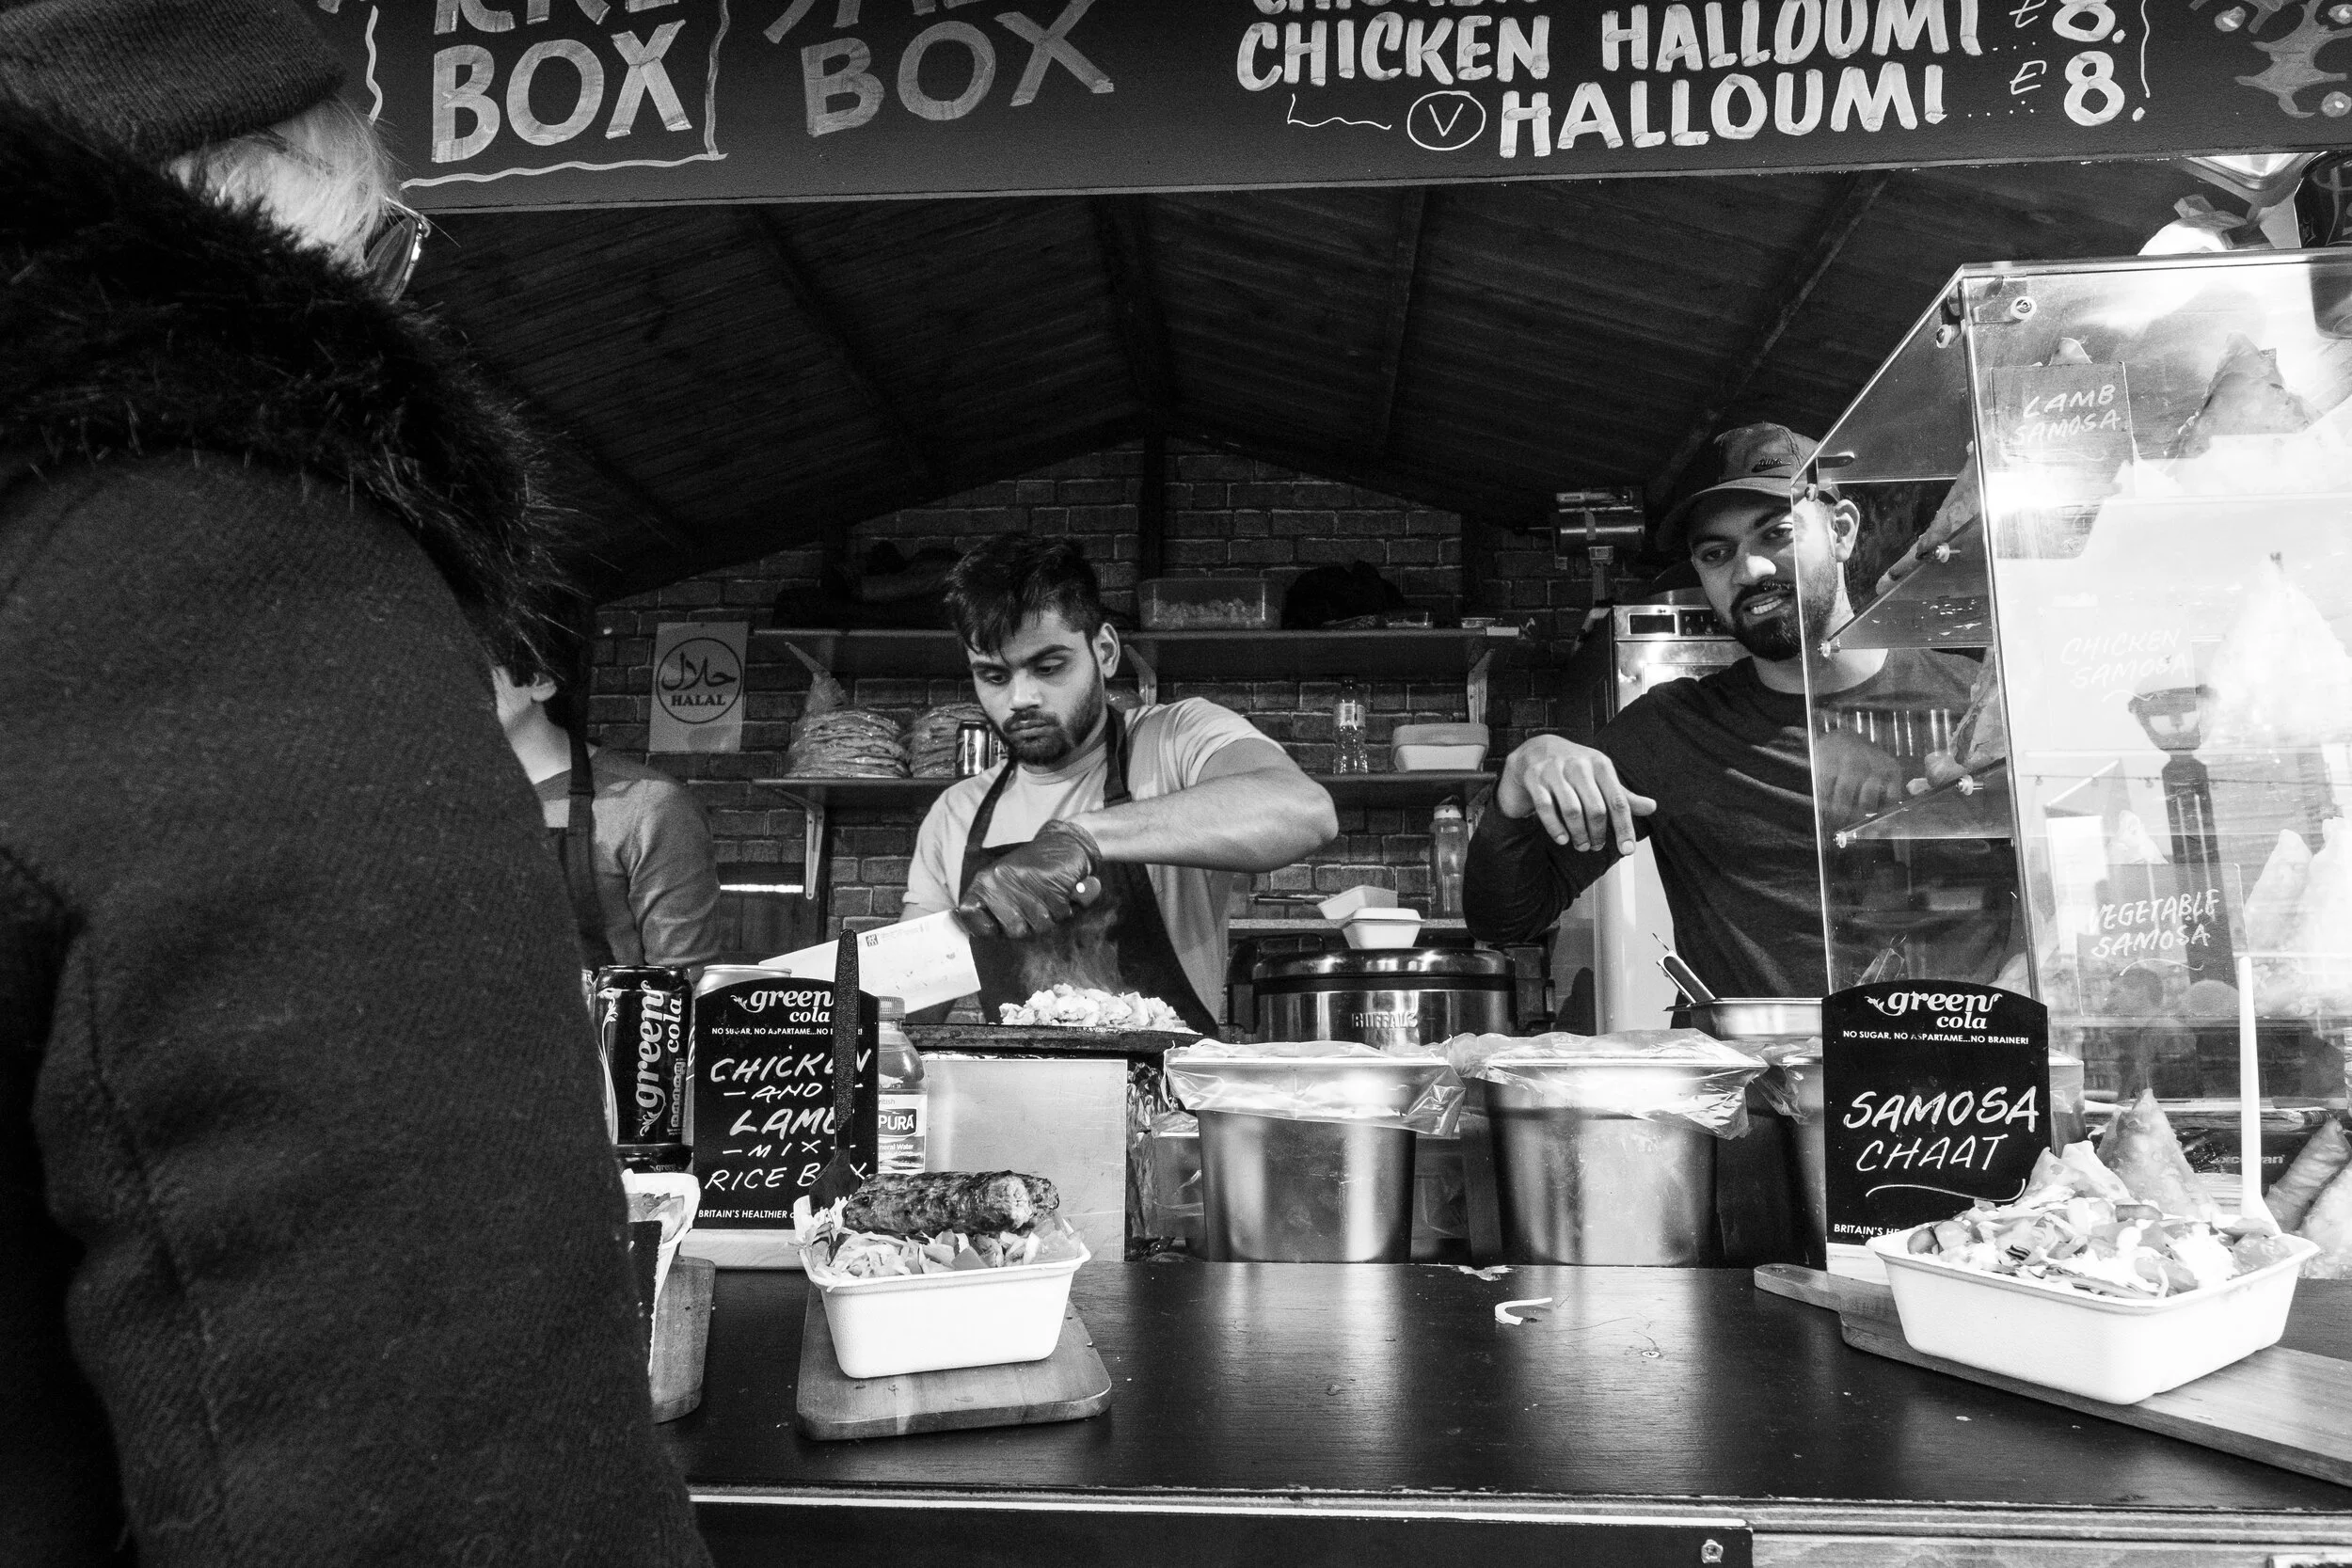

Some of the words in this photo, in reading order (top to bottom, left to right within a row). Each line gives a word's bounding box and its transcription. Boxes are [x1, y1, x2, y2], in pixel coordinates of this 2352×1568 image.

[1236, 11, 1550, 91] CHICKEN
[1601, 0, 1983, 72] HALLOUMI
[801, 0, 1115, 138] BOX
[431, 20, 693, 164] BOX
[1499, 61, 1947, 158] HALLOUMI
[2022, 383, 2117, 419] LAMB
[2013, 408, 2122, 445] SAMOSA
[2059, 627, 2182, 666] CHICKEN
[660, 652, 738, 691] حلال
[2070, 651, 2190, 689] SAMOSA
[670, 694, 726, 706] HALAL
[2089, 888, 2220, 935] VEGETABLE
[2090, 923, 2212, 958] SAMOSA
[734, 990, 835, 1014] green
[789, 1006, 832, 1023] cola
[1867, 990, 2003, 1017] green
[1936, 1011, 1988, 1029] cola
[662, 996, 682, 1053] cola
[711, 1027, 724, 1036] NO
[754, 1027, 767, 1036] NO
[1843, 1030, 1857, 1038] NO
[1858, 1031, 1892, 1040] SUGAR,
[1894, 1032, 1909, 1040] NO
[1988, 1036, 2029, 1045] BRAINER!
[635, 979, 667, 1129] green
[751, 1083, 823, 1103] AND
[1842, 1085, 2040, 1132] SAMOSA
[748, 1138, 821, 1160] MIX
[1855, 1133, 2009, 1172] CHAAT
[705, 1166, 788, 1192] RICE
[796, 1162, 867, 1186] BX
[698, 1209, 739, 1219] BRITAIN'S
[741, 1210, 787, 1219] HEALTHIER
[1833, 1223, 1883, 1236] BRITAIN'S
